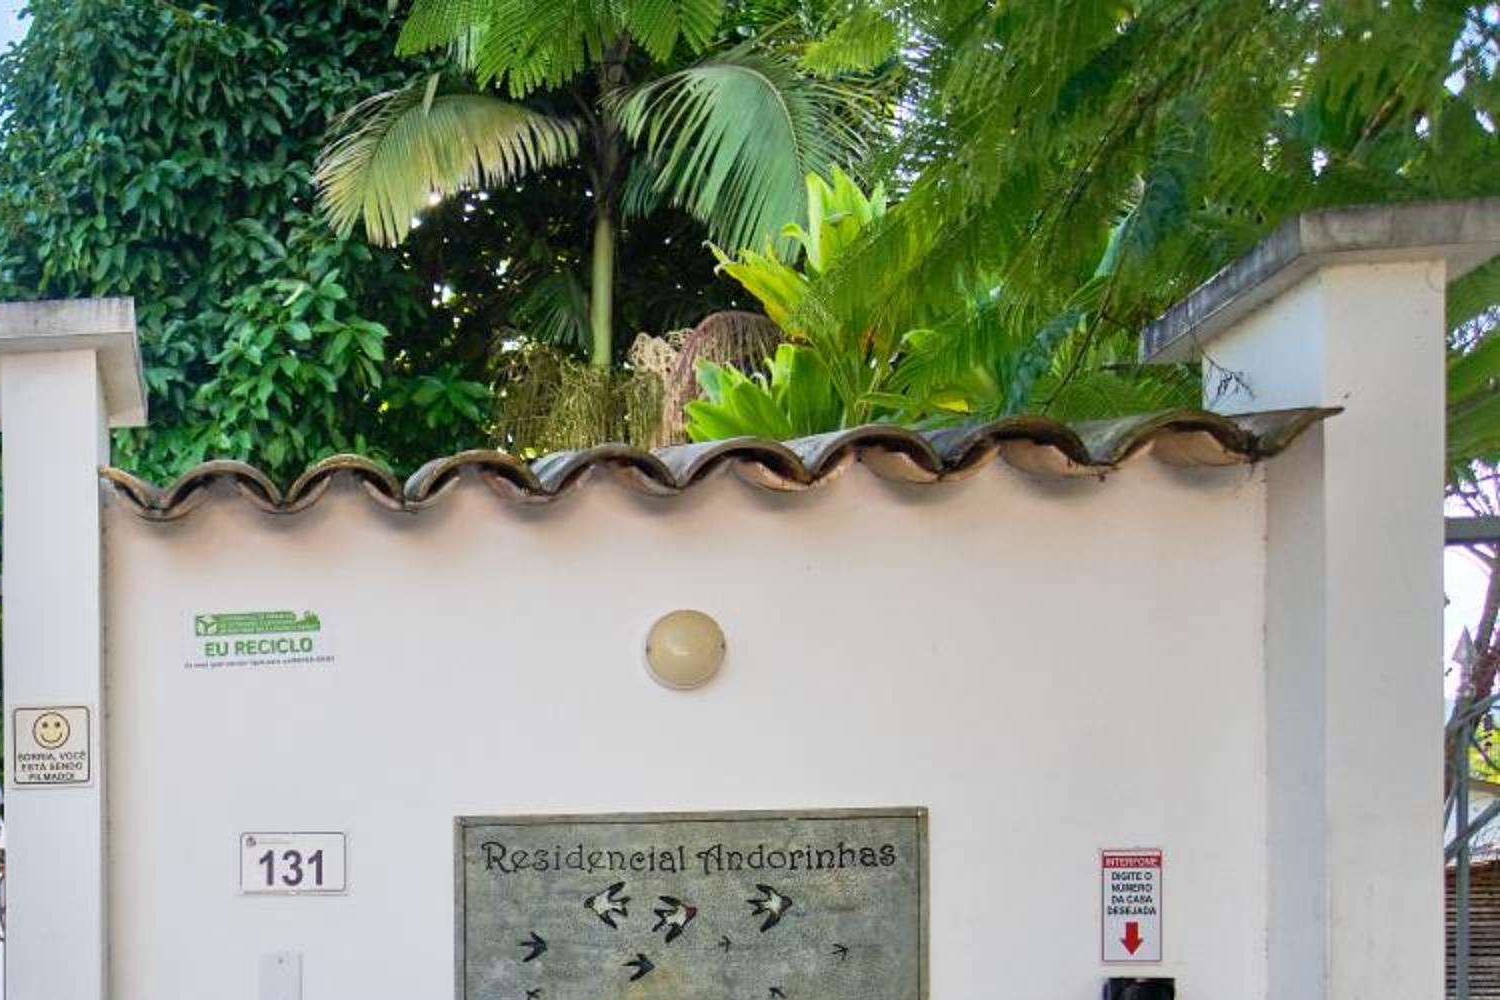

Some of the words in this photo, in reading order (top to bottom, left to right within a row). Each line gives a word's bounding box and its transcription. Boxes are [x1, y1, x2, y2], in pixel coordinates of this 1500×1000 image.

[204, 641, 229, 657] EU
[235, 637, 314, 656] RECICLO
[481, 841, 686, 875] Residencial
[696, 841, 897, 876] Andorinhas
[259, 849, 324, 887] 131
[1111, 871, 1142, 880] DIGITE
[1144, 871, 1153, 880] O
[1111, 895, 1124, 904] DA
[1126, 895, 1153, 904] CASA
[1107, 905, 1157, 915] DESEJADA
